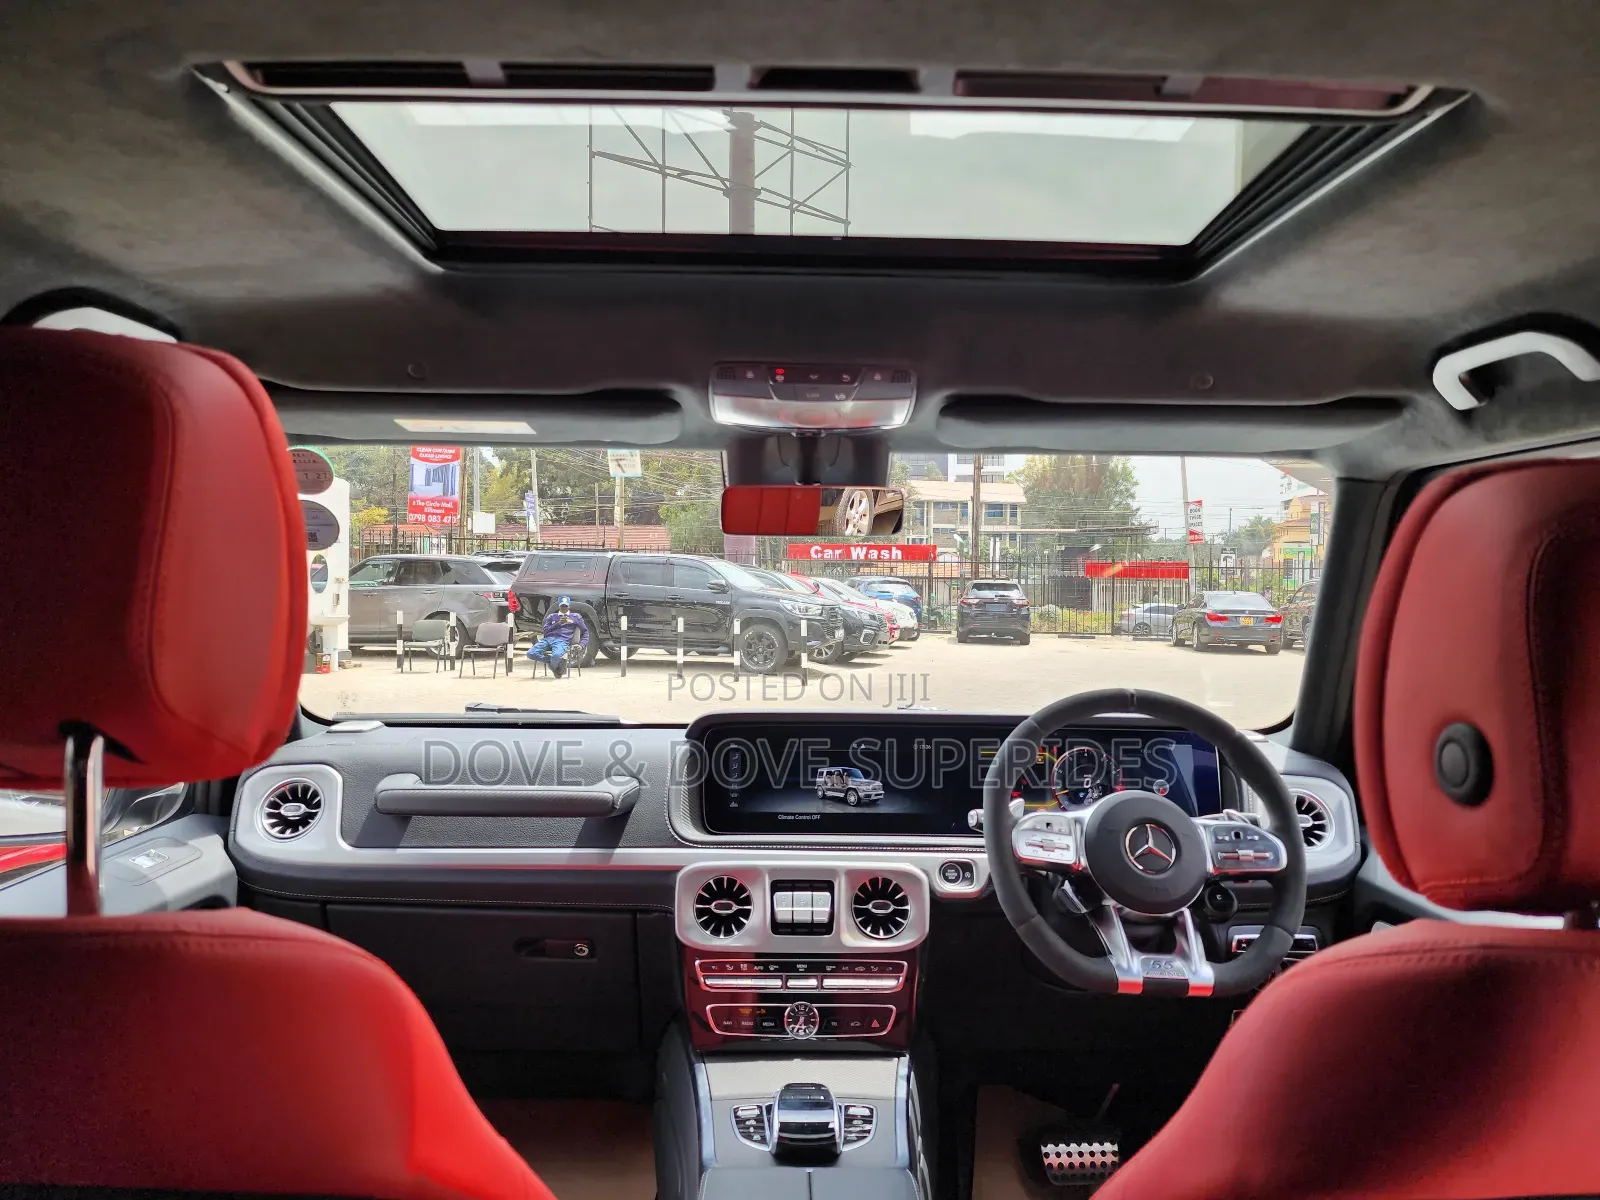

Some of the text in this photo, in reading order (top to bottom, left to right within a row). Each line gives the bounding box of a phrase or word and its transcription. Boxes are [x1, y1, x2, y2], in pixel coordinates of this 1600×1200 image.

[409, 513, 426, 522] 0798
[428, 515, 441, 523] 083
[810, 545, 902, 560] Car Wash
[1083, 777, 1092, 789] 0
